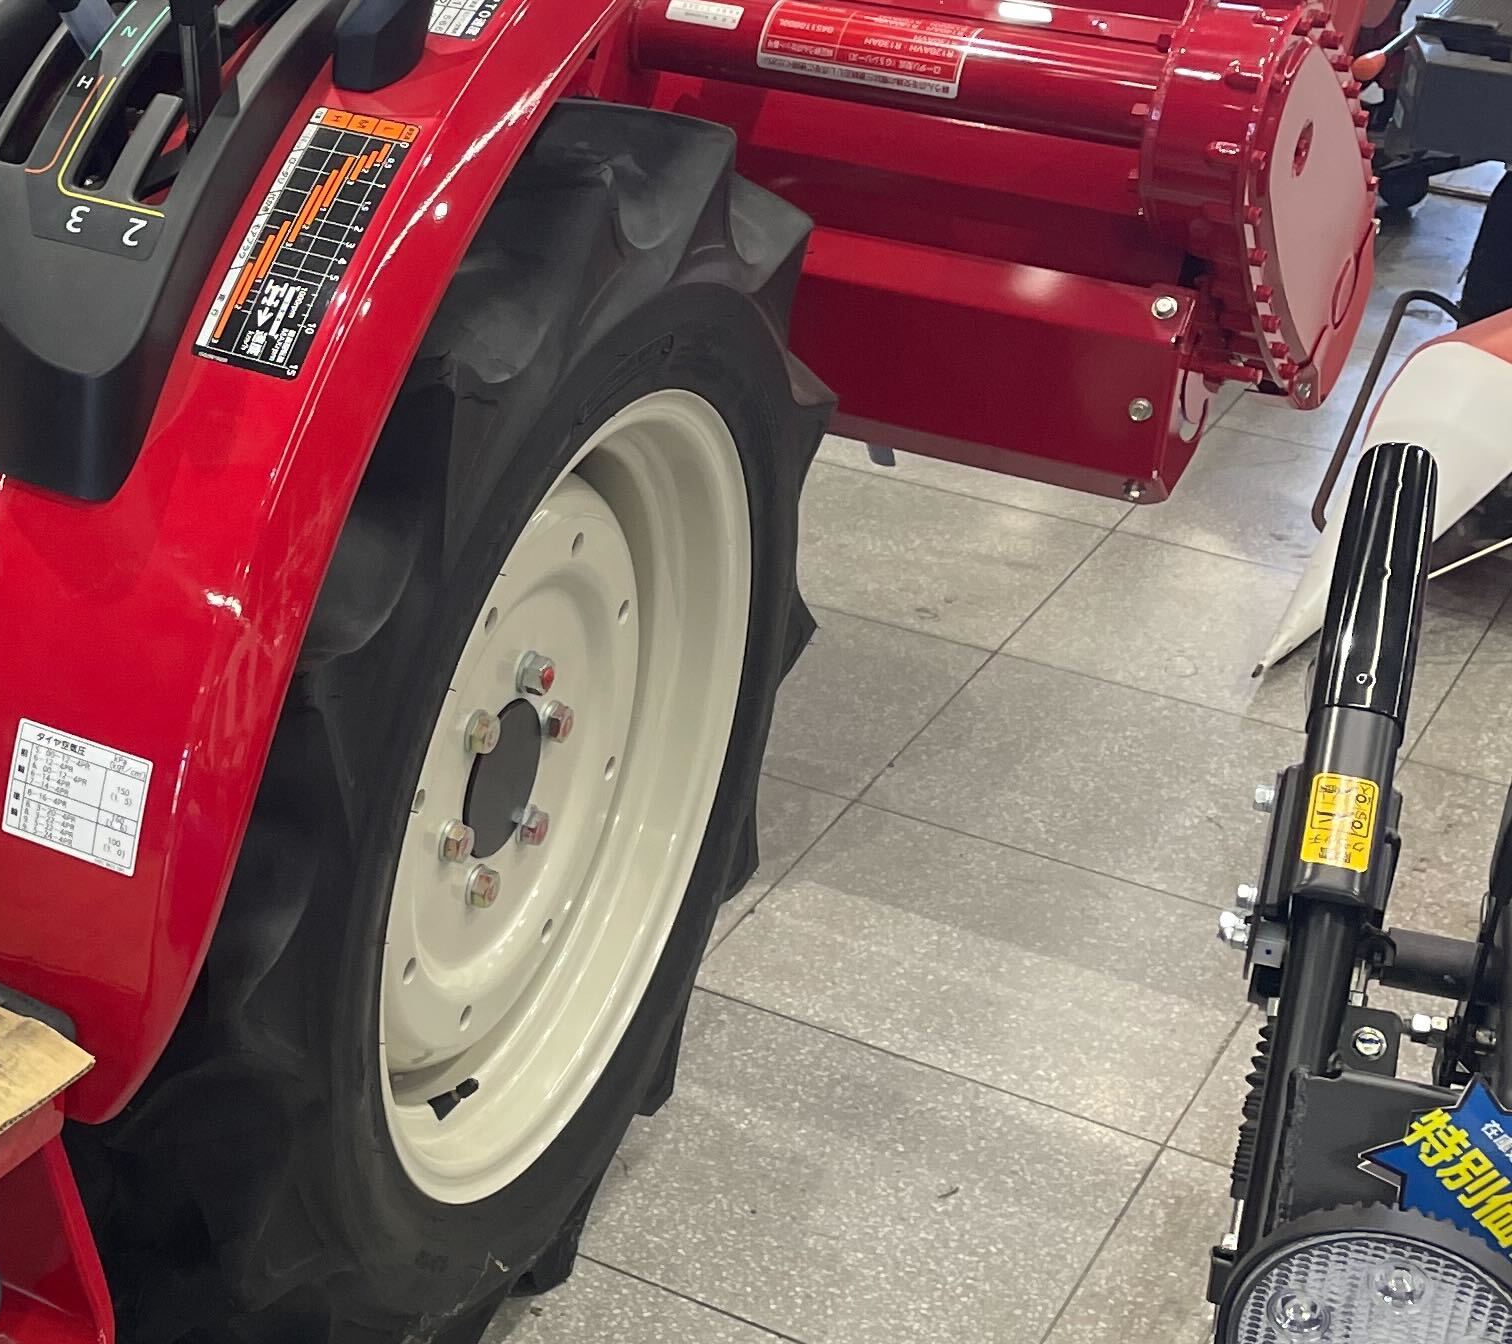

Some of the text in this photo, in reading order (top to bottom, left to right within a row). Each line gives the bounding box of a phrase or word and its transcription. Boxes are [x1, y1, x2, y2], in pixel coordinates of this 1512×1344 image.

[120, 26, 139, 39] N
[77, 75, 94, 89] H
[65, 205, 148, 247] 3 2
[351, 224, 364, 235] 2
[343, 240, 356, 250] 3
[335, 256, 348, 267] 4
[287, 286, 309, 319] 1000rpm
[303, 321, 317, 337] 10
[240, 329, 255, 352] km/h
[285, 363, 299, 378] 15
[35, 732, 87, 756] タイヤ空気圧
